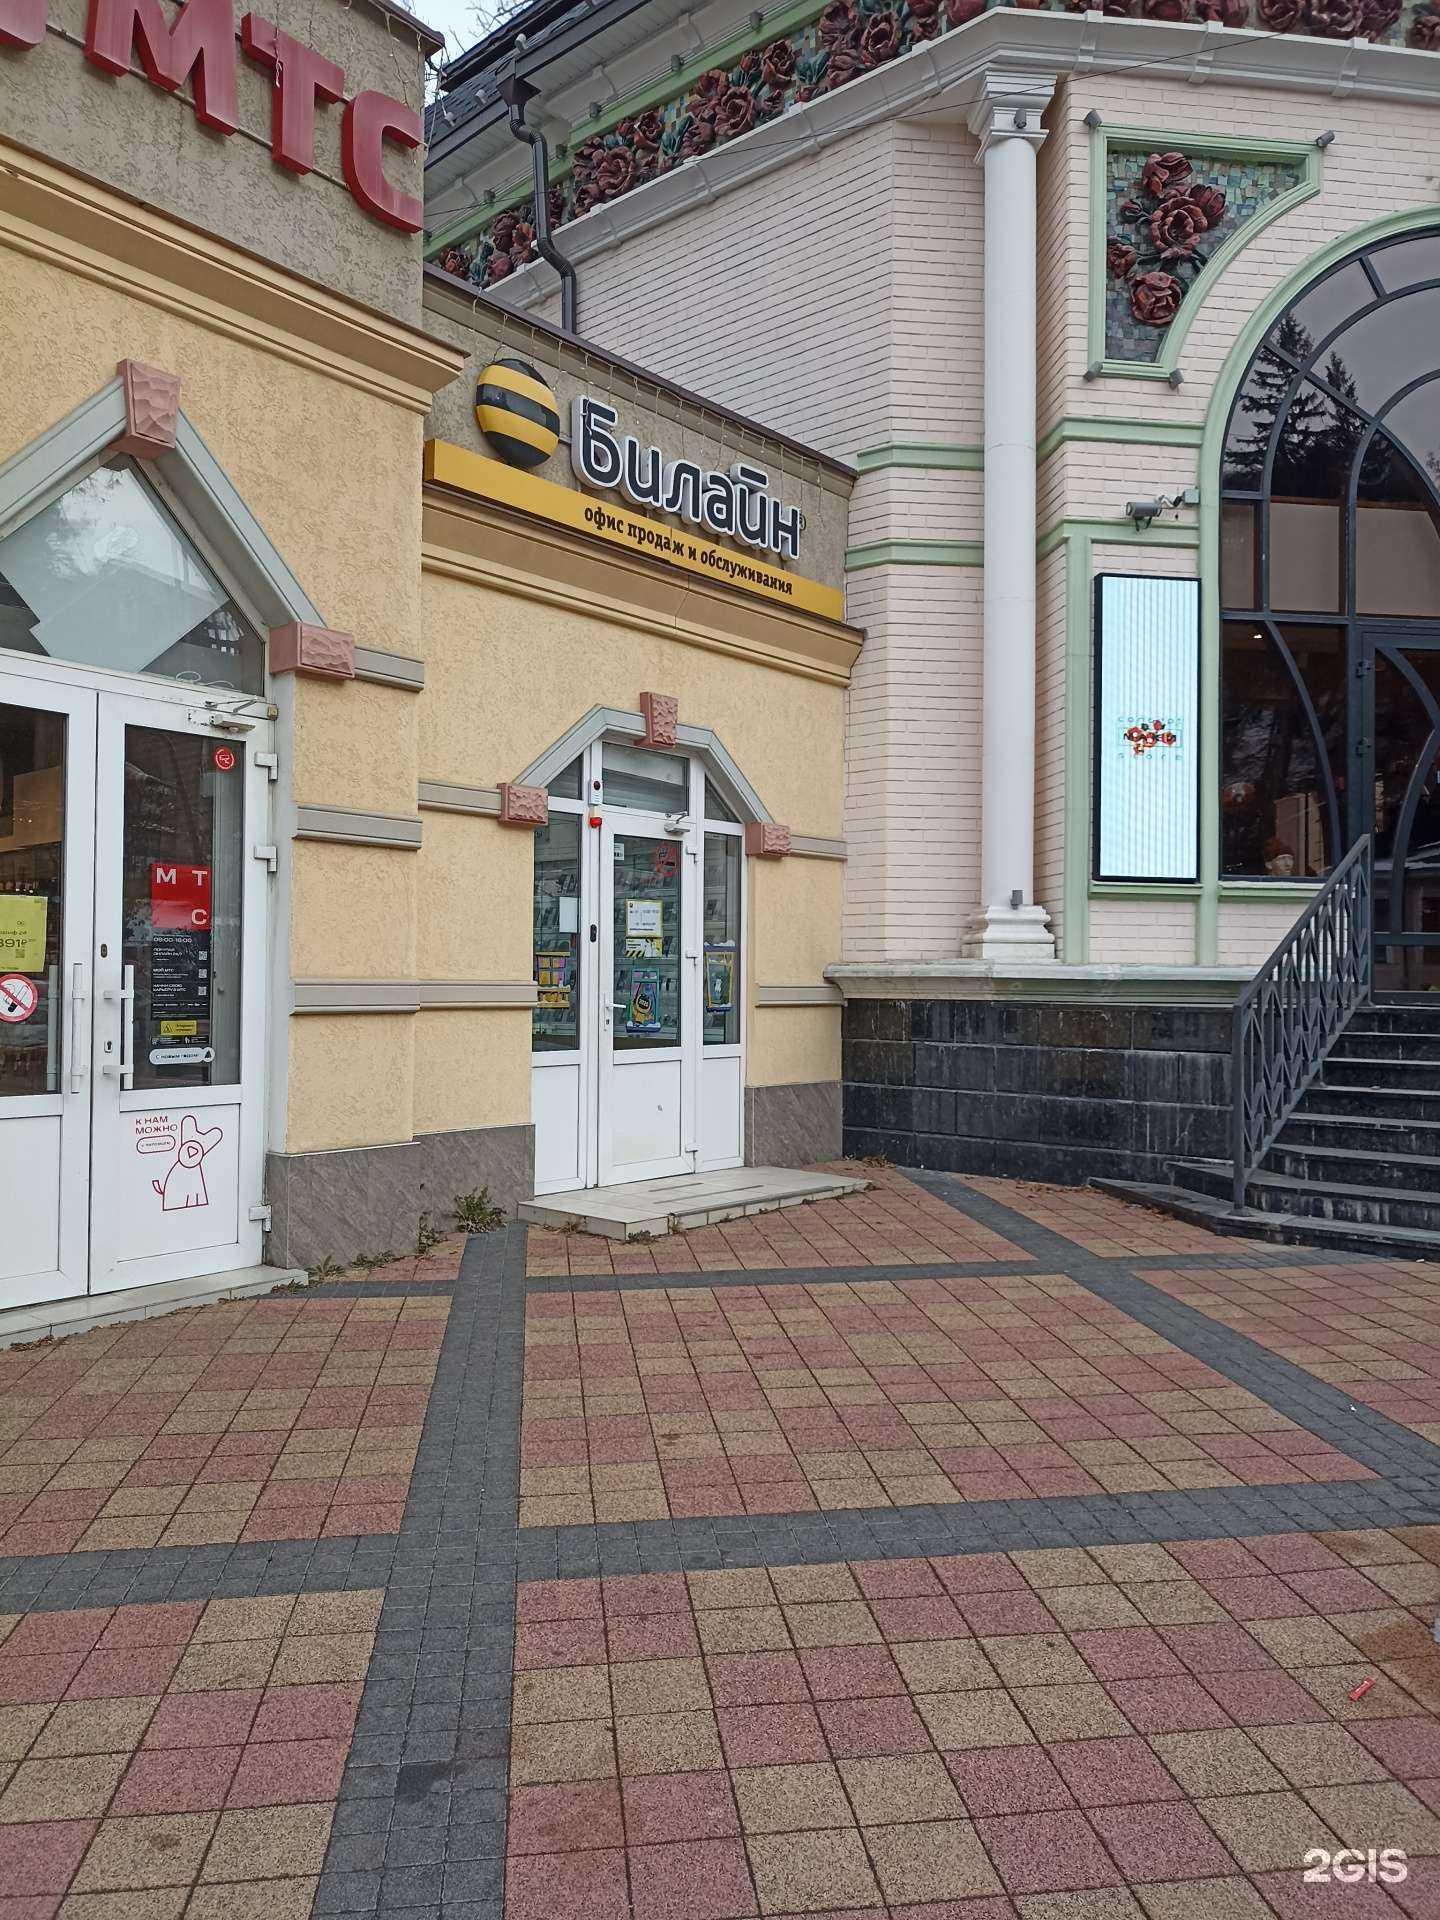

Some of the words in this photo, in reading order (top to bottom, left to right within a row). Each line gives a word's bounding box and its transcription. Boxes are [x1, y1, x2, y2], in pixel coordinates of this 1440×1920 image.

[85, 0, 424, 234] МТС
[583, 506, 625, 536] офис
[627, 523, 685, 559] продаж
[687, 546, 698, 561] и
[700, 549, 793, 595] обслуживания
[135, 1118, 142, 1126] К
[144, 1116, 168, 1124] НАМ
[135, 1123, 178, 1135] МОЖНО
